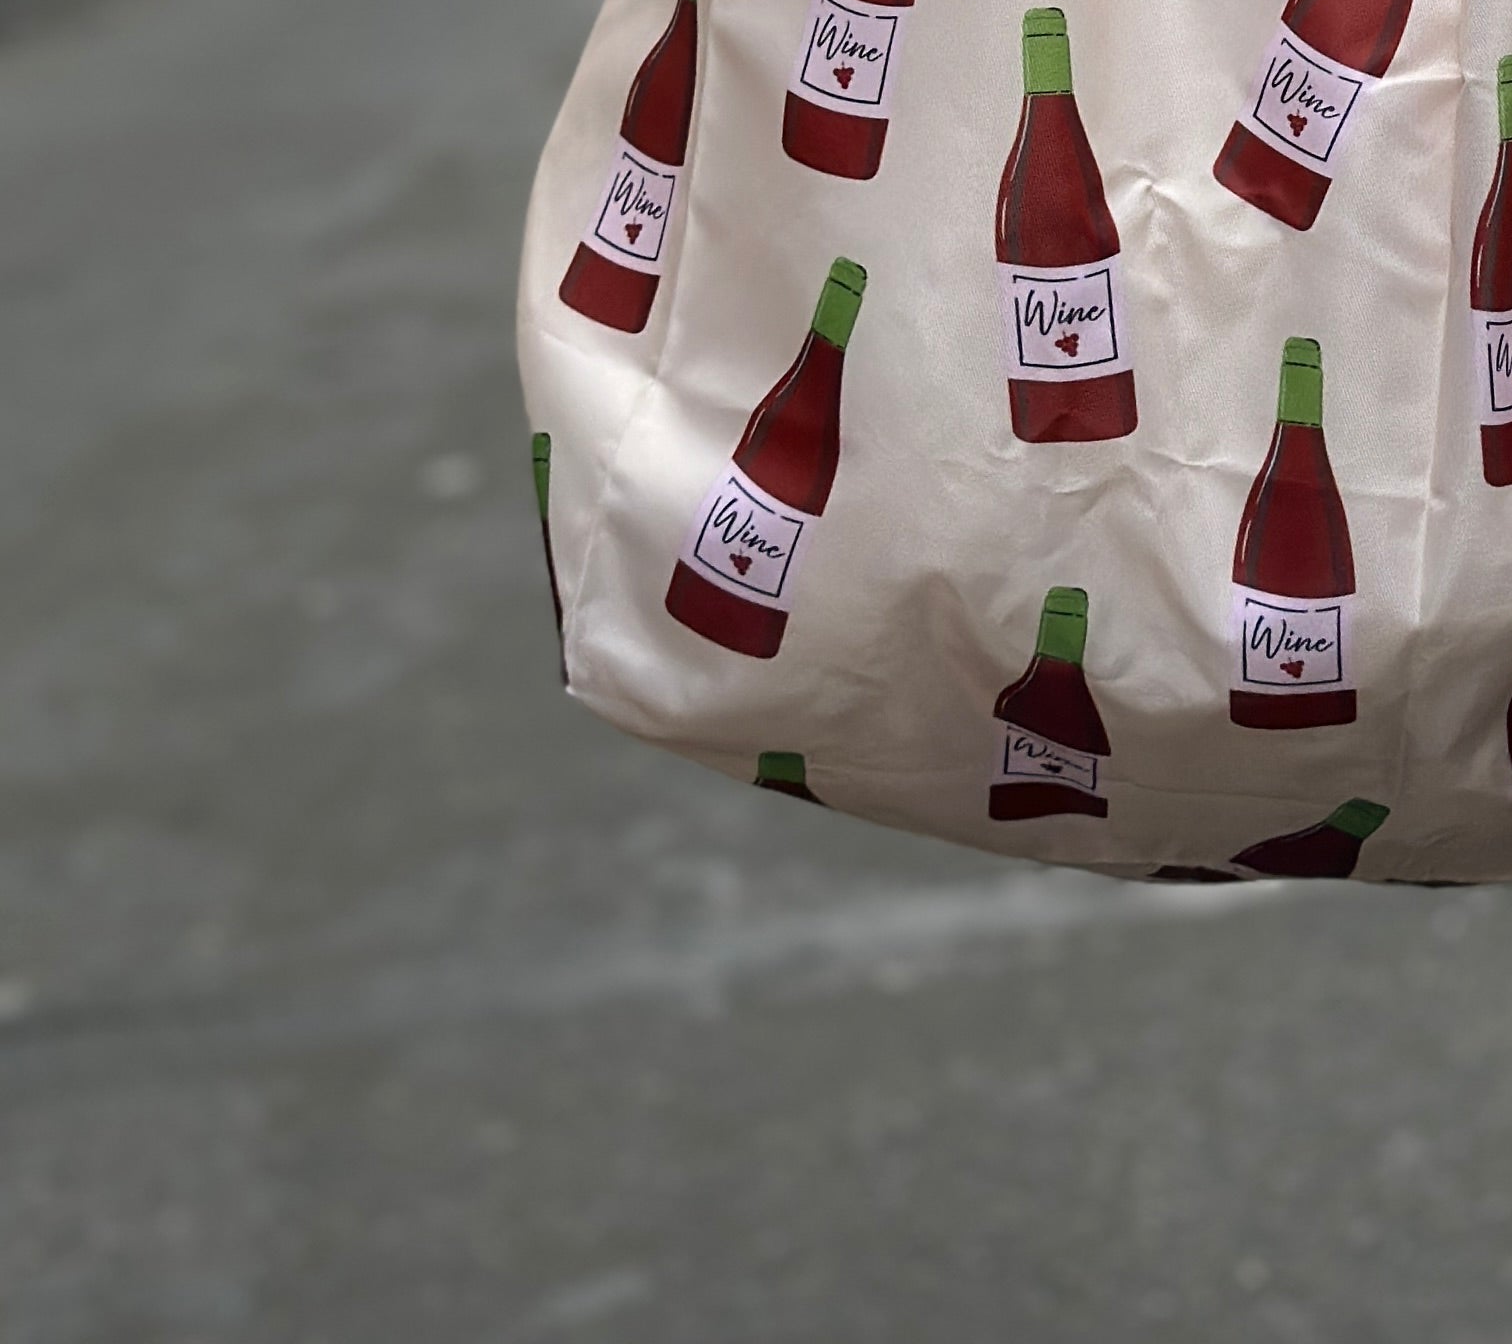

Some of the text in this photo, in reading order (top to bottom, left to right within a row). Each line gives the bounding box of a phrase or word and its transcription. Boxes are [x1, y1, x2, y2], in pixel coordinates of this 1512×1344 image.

[816, 13, 882, 61] Wine
[1272, 59, 1339, 118] Wine
[614, 170, 666, 219] Wine
[1023, 290, 1105, 335] Wine
[714, 498, 786, 558] Wine
[1251, 615, 1334, 657] Wine
